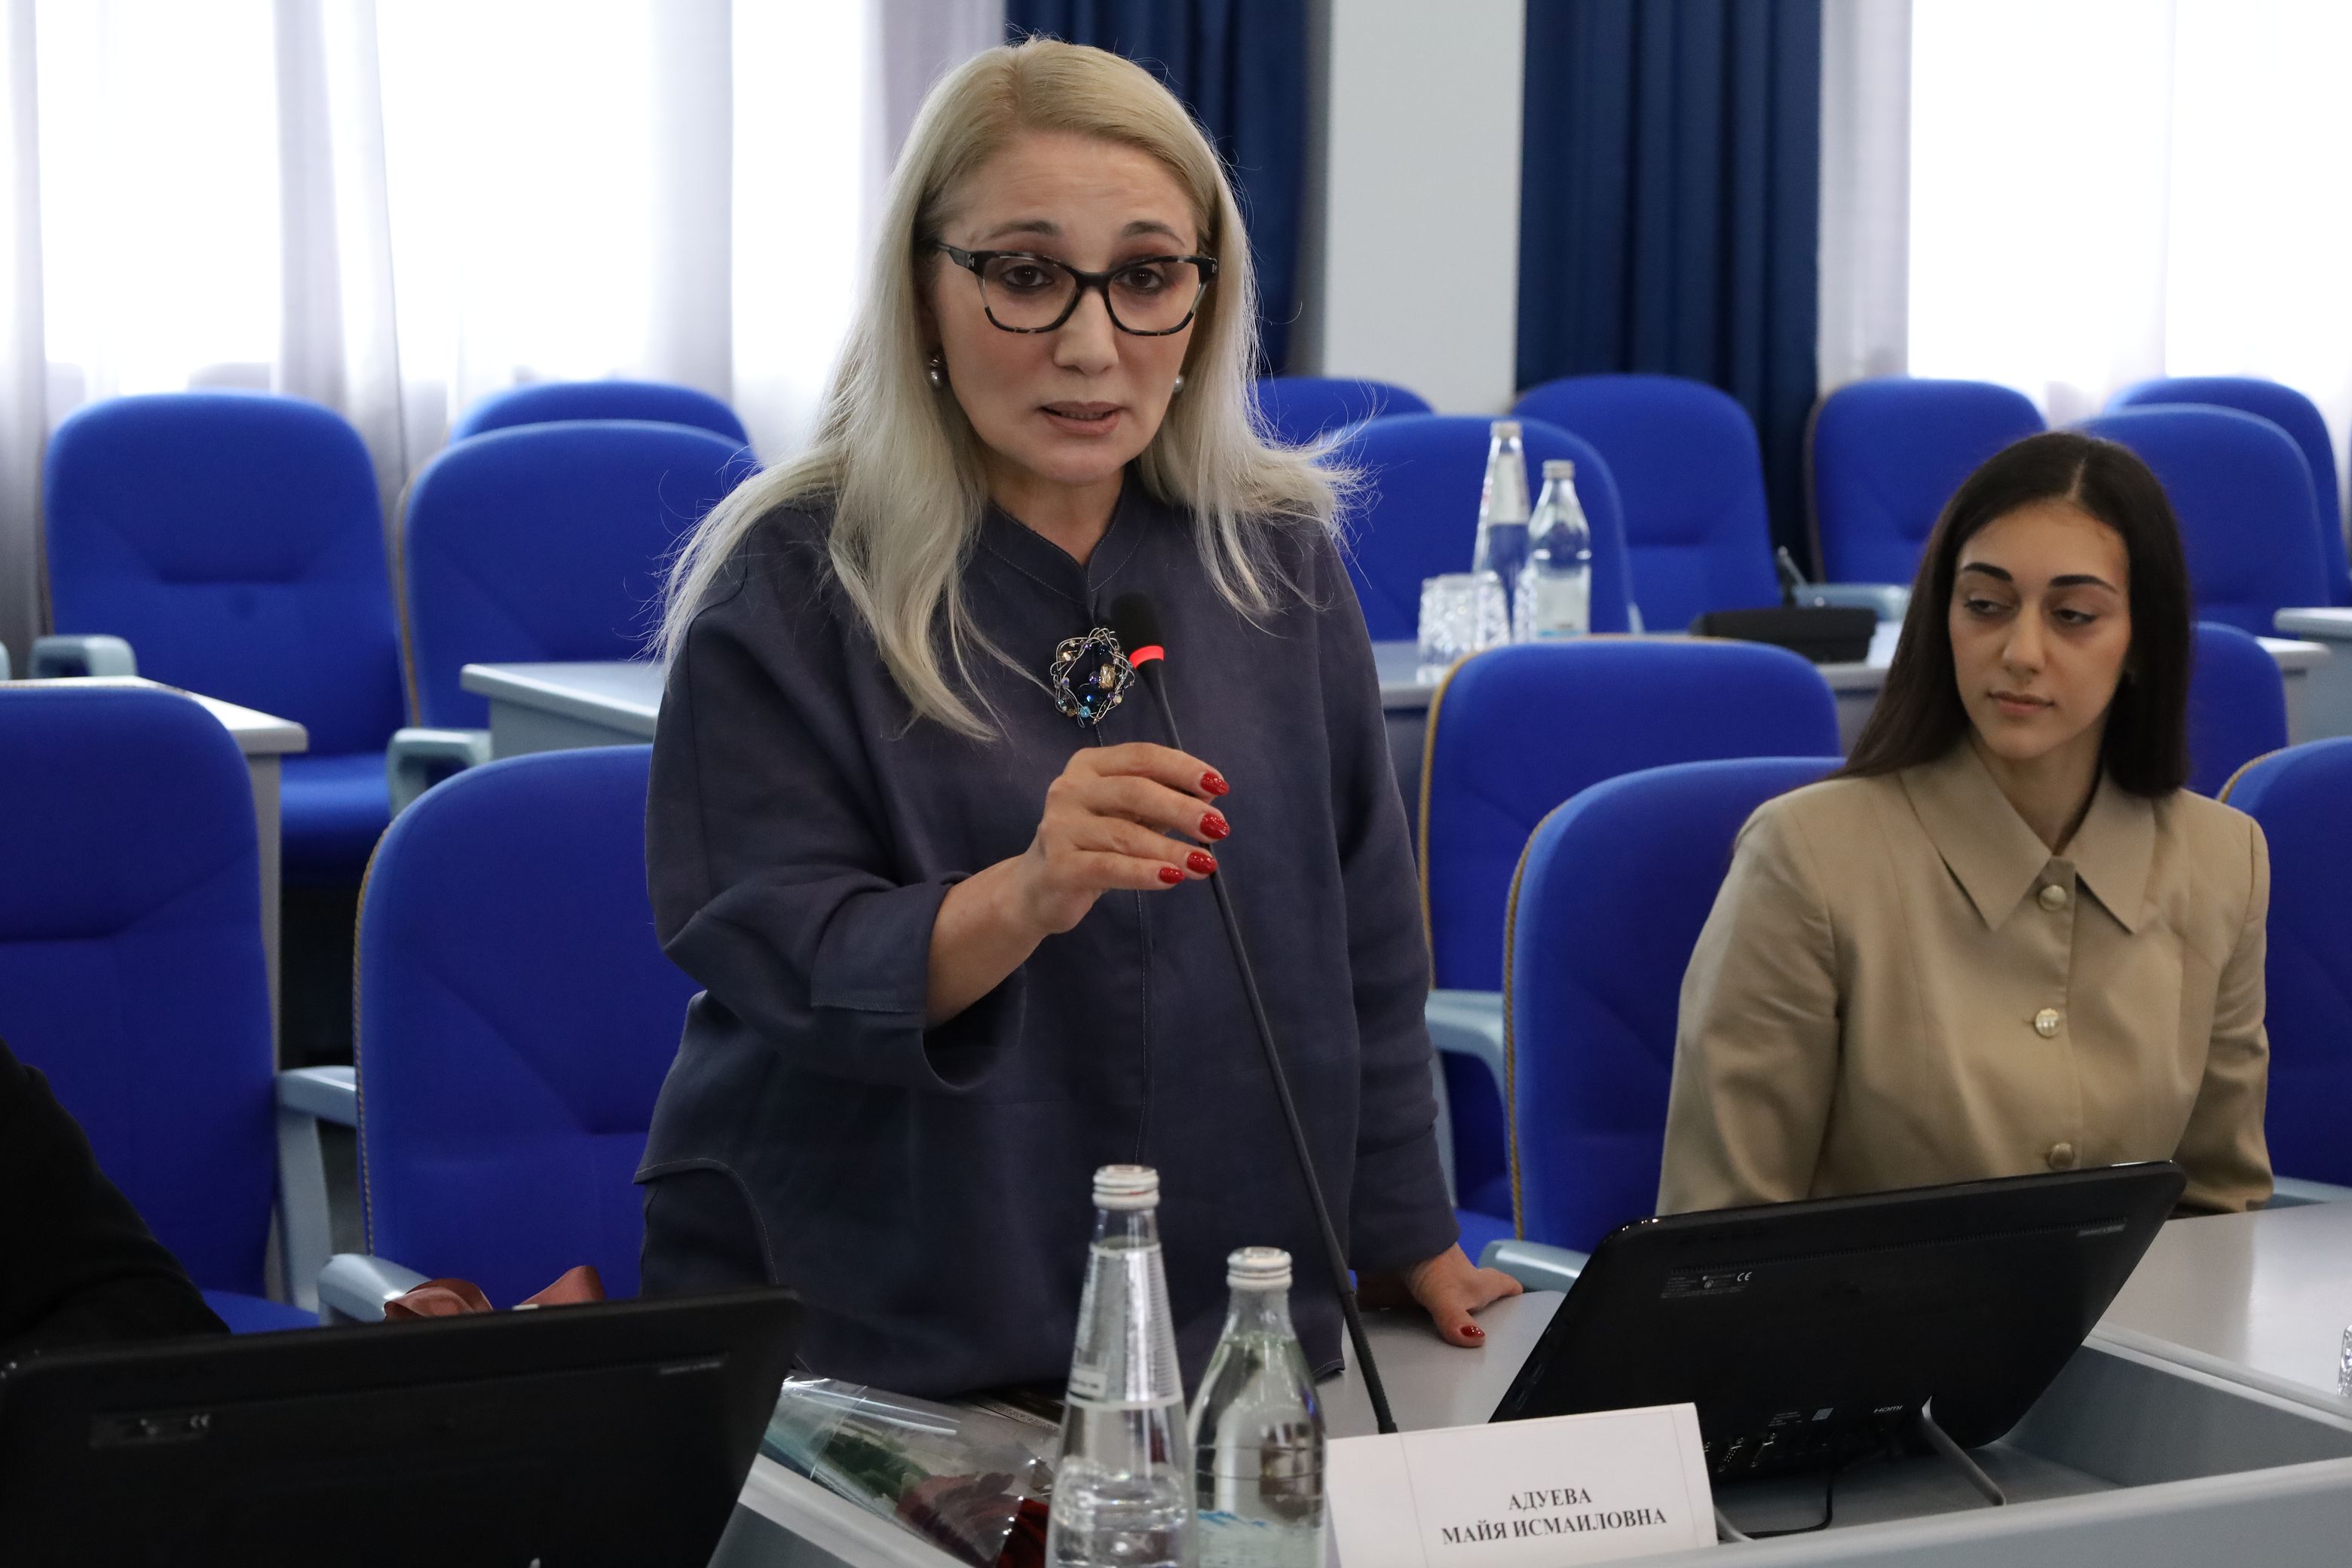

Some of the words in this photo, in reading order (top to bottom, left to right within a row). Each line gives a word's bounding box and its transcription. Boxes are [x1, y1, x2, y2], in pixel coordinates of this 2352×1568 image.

[1873, 1404, 1903, 1413] HDMI
[1508, 1487, 1593, 1511] АДУЕВА
[1441, 1519, 1508, 1545] МАЙЯ
[1513, 1508, 1668, 1539] ИСМАИЛОВНА
